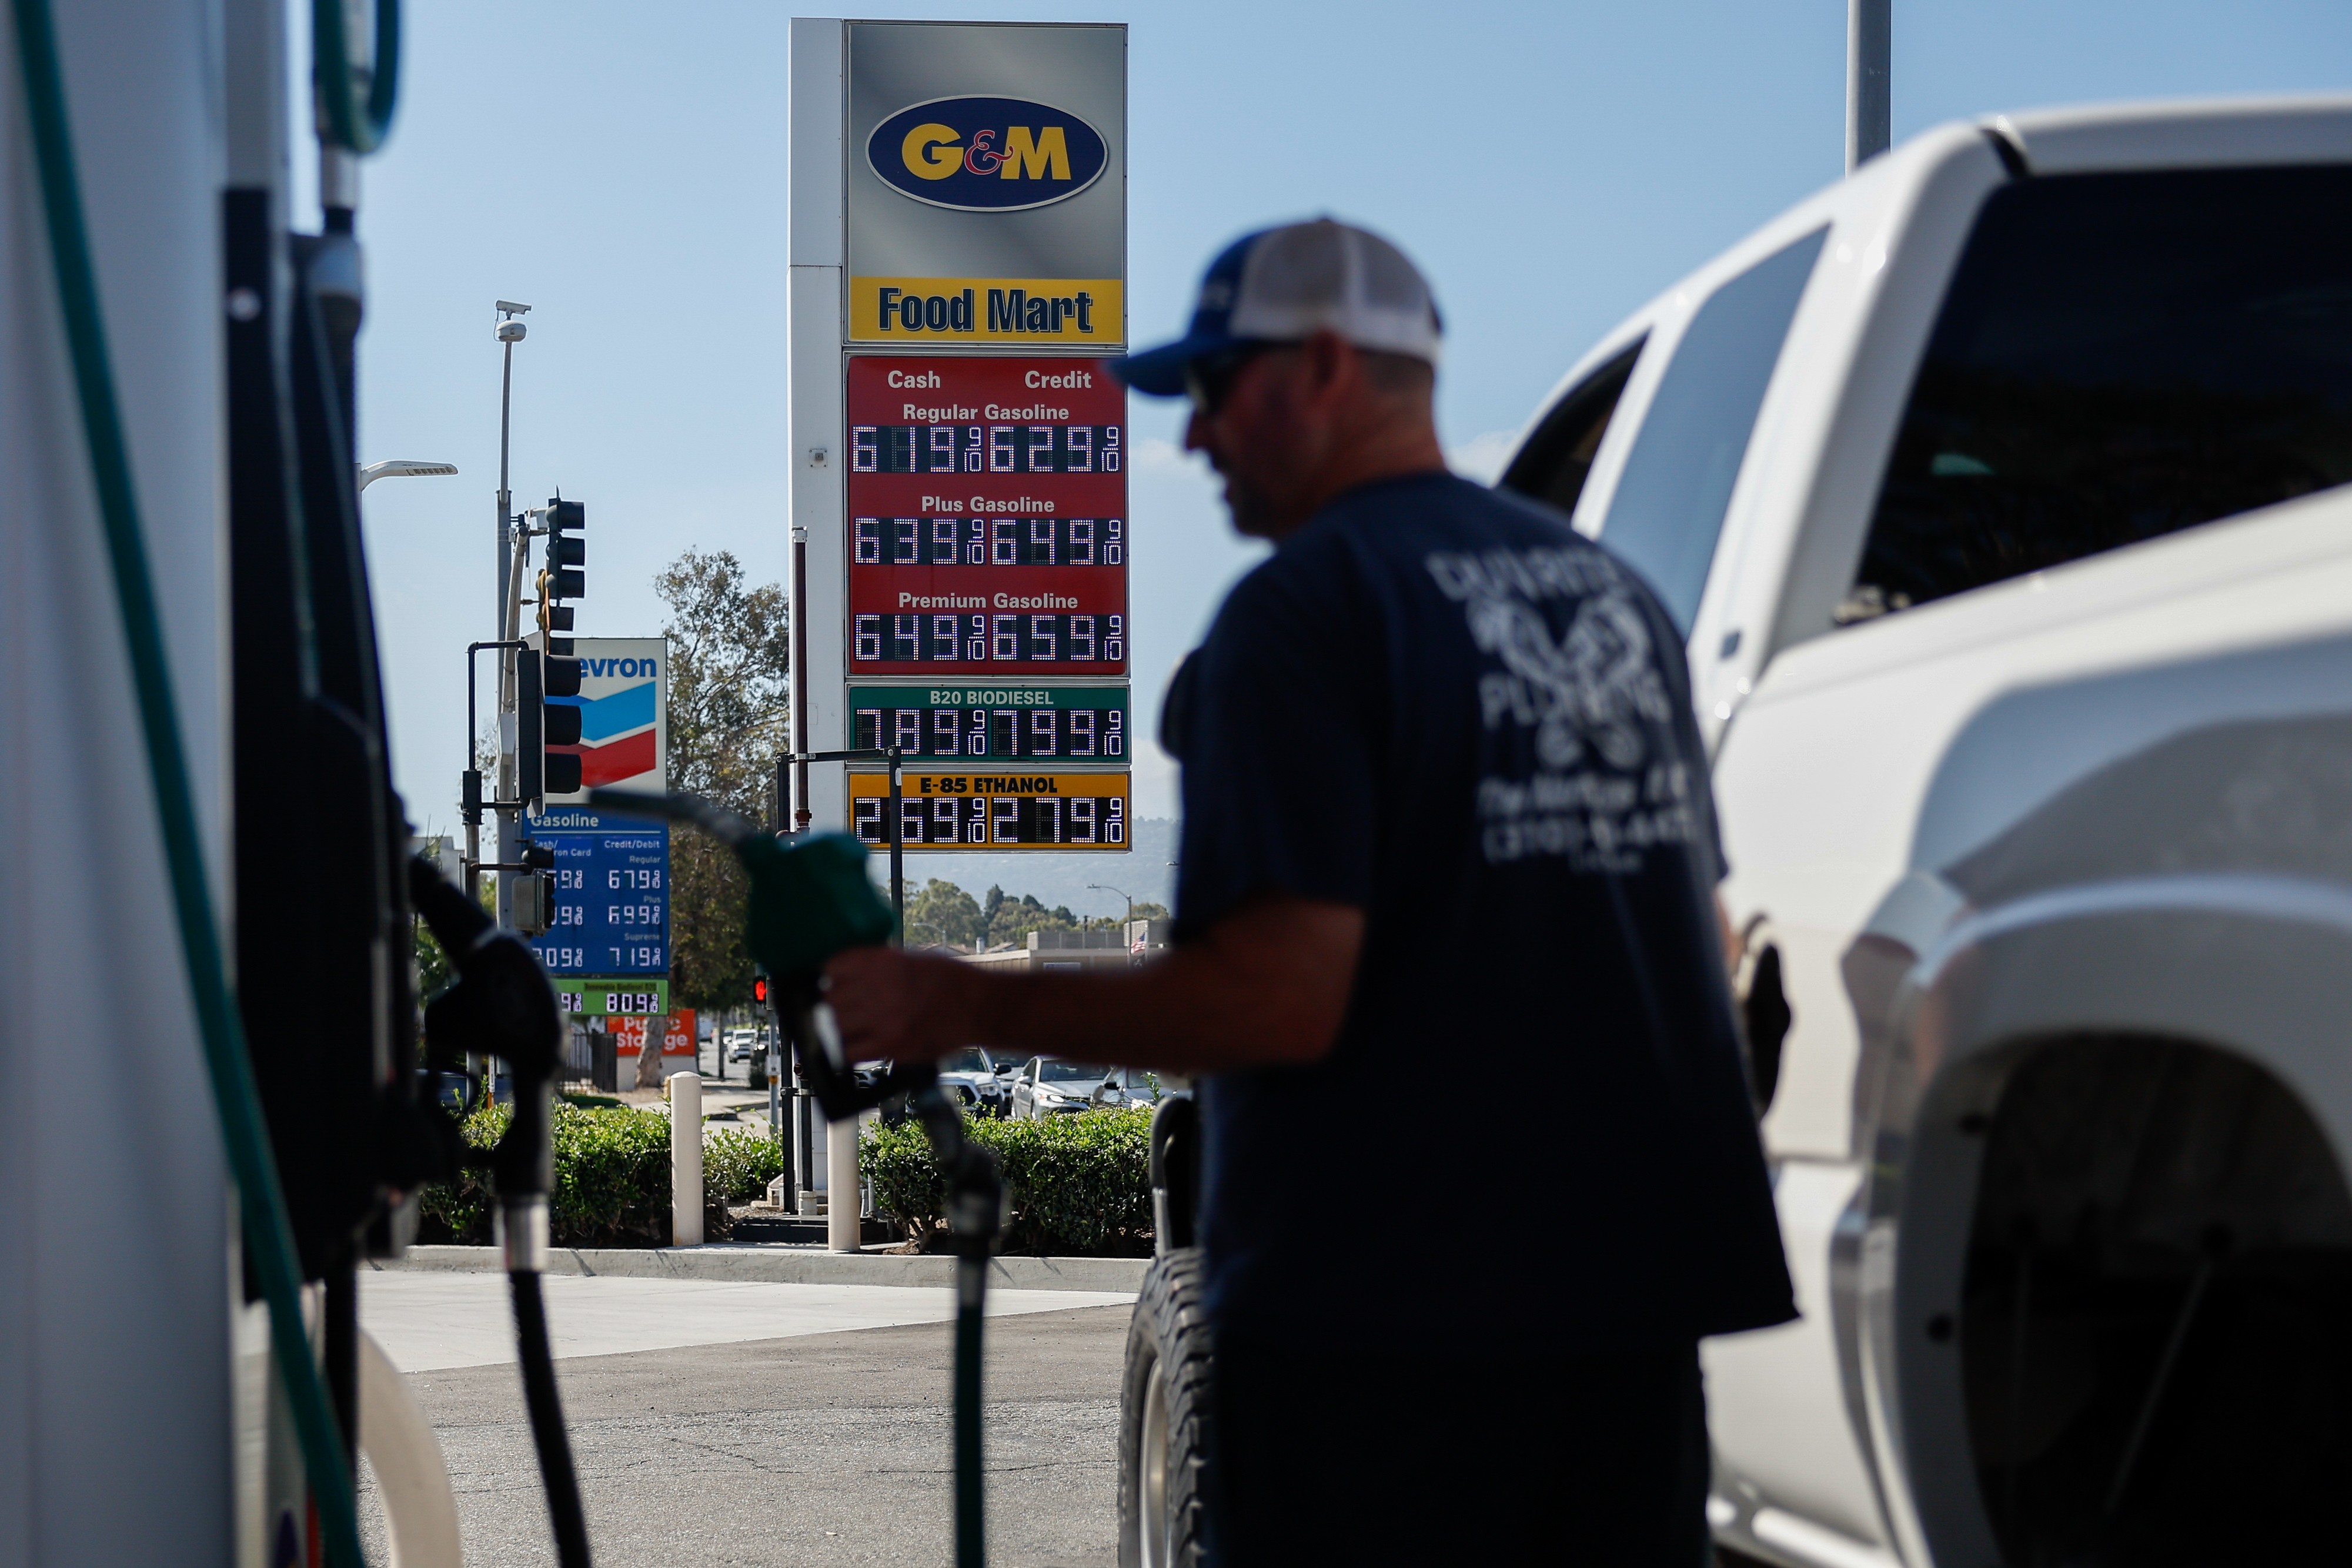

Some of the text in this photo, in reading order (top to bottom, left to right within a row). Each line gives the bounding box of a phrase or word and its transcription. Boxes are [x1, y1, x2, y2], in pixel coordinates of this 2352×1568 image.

[901, 122, 1072, 180] G&M
[878, 287, 1094, 333] Food Mart
[887, 370, 1091, 389] Cash Credit
[903, 404, 1069, 423] Regular Gasoline
[921, 496, 1055, 513] Plus Gasoline
[898, 592, 1078, 609] Premium Gasoline
[580, 658, 656, 678] evron
[930, 691, 1054, 704] B20 BIODIESEL
[920, 777, 1057, 794] E-85 ETHANOL
[531, 813, 599, 828] Gasoline
[604, 840, 660, 849] Credit/Debit
[629, 855, 662, 864] Regular
[643, 895, 662, 904] Plus
[624, 933, 660, 941] Supreme
[624, 1017, 681, 1031] Puc
[617, 1032, 689, 1051] Stoge
